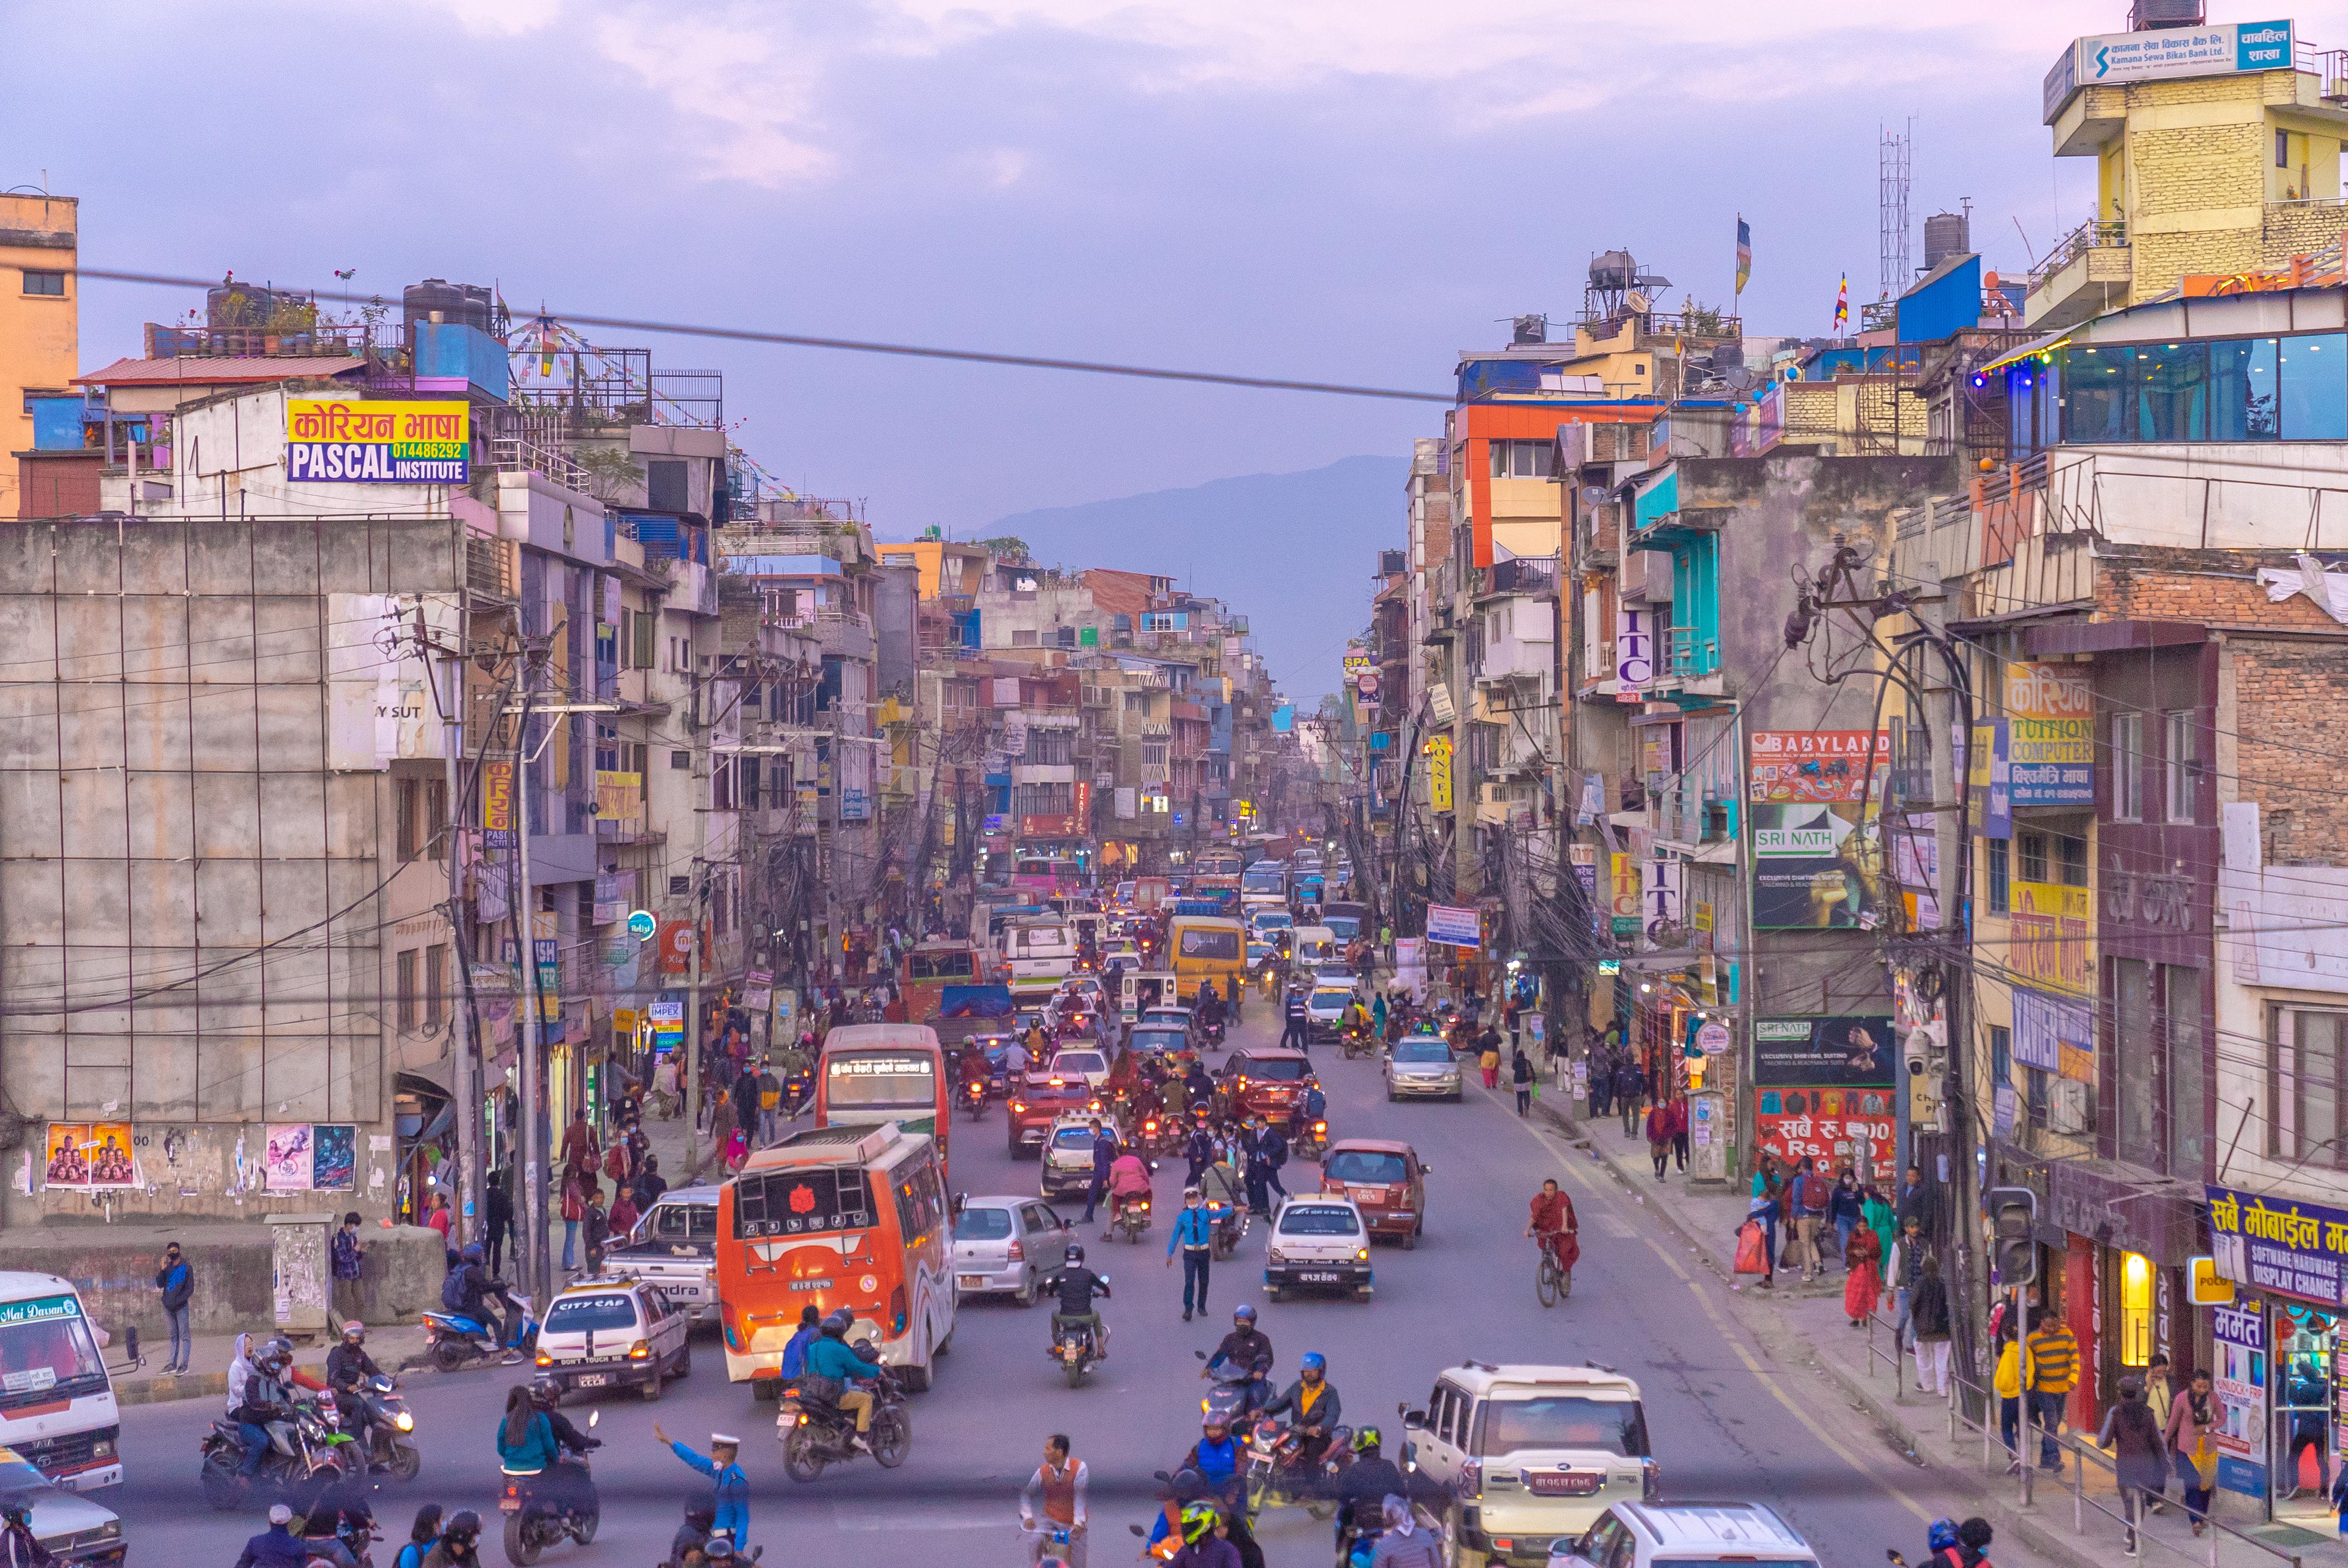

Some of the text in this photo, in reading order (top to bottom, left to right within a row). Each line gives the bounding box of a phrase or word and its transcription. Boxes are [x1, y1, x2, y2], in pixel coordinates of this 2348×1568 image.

[2144, 40, 2159, 51] सेवा
[2162, 38, 2190, 49] विकास
[2241, 29, 2288, 44] चाबहिल
[2111, 47, 2225, 65] Kamana Sewa Bikas Bank Ltd.
[2248, 49, 2281, 62] शाखा
[295, 404, 461, 441] कोरियन भाषा
[393, 443, 461, 458] 014486292
[292, 444, 462, 479] PASCAL INSTITUTE
[1619, 610, 1650, 683] ITC
[1344, 657, 1371, 667] SPA
[2011, 666, 2090, 714] कोरियन
[375, 706, 421, 718] Y SUT
[2012, 719, 2092, 739] TUITION
[1772, 736, 1889, 752] BABYLAND
[2011, 741, 2092, 761] COMPUTER
[1434, 737, 1446, 802] YONSEI
[1758, 832, 1832, 845] SRI NATH
[1613, 857, 1635, 915] ITC
[1781, 1024, 1810, 1033] NATH
[1779, 1115, 1813, 1139] सबै
[1820, 1121, 1842, 1139] रु.
[1788, 1141, 1827, 1156] Rs.
[2210, 1192, 2239, 1232] सबै
[2244, 1198, 2320, 1250] मोबाईल
[2251, 1245, 2338, 1278] SOFTWARE HARDWARE
[658, 1285, 699, 1296] ndra
[2252, 1264, 2338, 1301] DISPLAY CHANGE
[27, 1304, 63, 1318] Darsan
[559, 1301, 593, 1311] CITY
[2215, 1303, 2262, 1346] मर्मत
[2249, 1387, 2263, 1400] FRP
